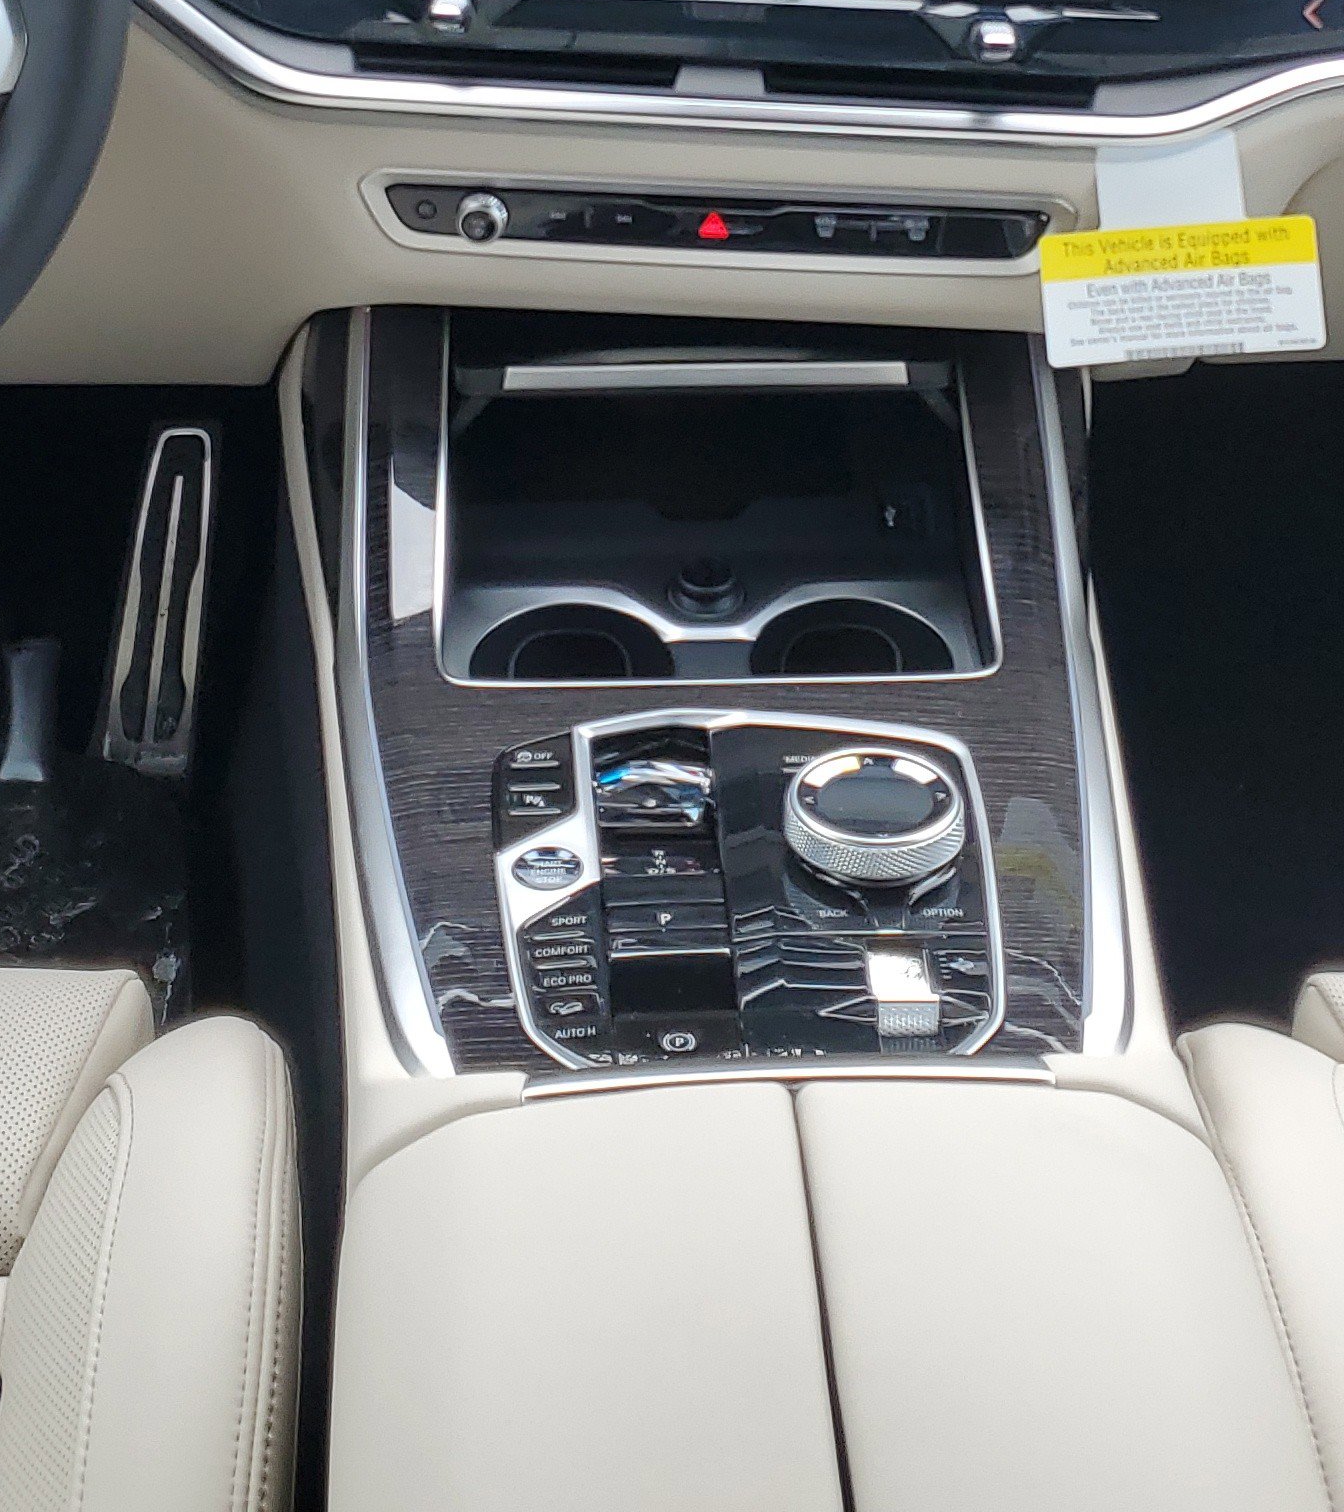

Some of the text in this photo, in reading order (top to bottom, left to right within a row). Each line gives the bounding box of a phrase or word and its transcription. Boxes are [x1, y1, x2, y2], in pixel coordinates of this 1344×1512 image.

[1063, 225, 1291, 258] This Vehicle is Equipped with
[1103, 250, 1249, 275] Advanced Air Bags
[1150, 274, 1214, 293] Advanced
[1239, 270, 1271, 287] Bags
[534, 751, 554, 760] OFF
[659, 913, 672, 925] P
[819, 908, 963, 918] BACK OPTION
[551, 916, 587, 926] SPORT
[535, 944, 588, 957] COMFORT
[543, 975, 592, 987] ECO PRO
[554, 1026, 596, 1038] AUTO H
